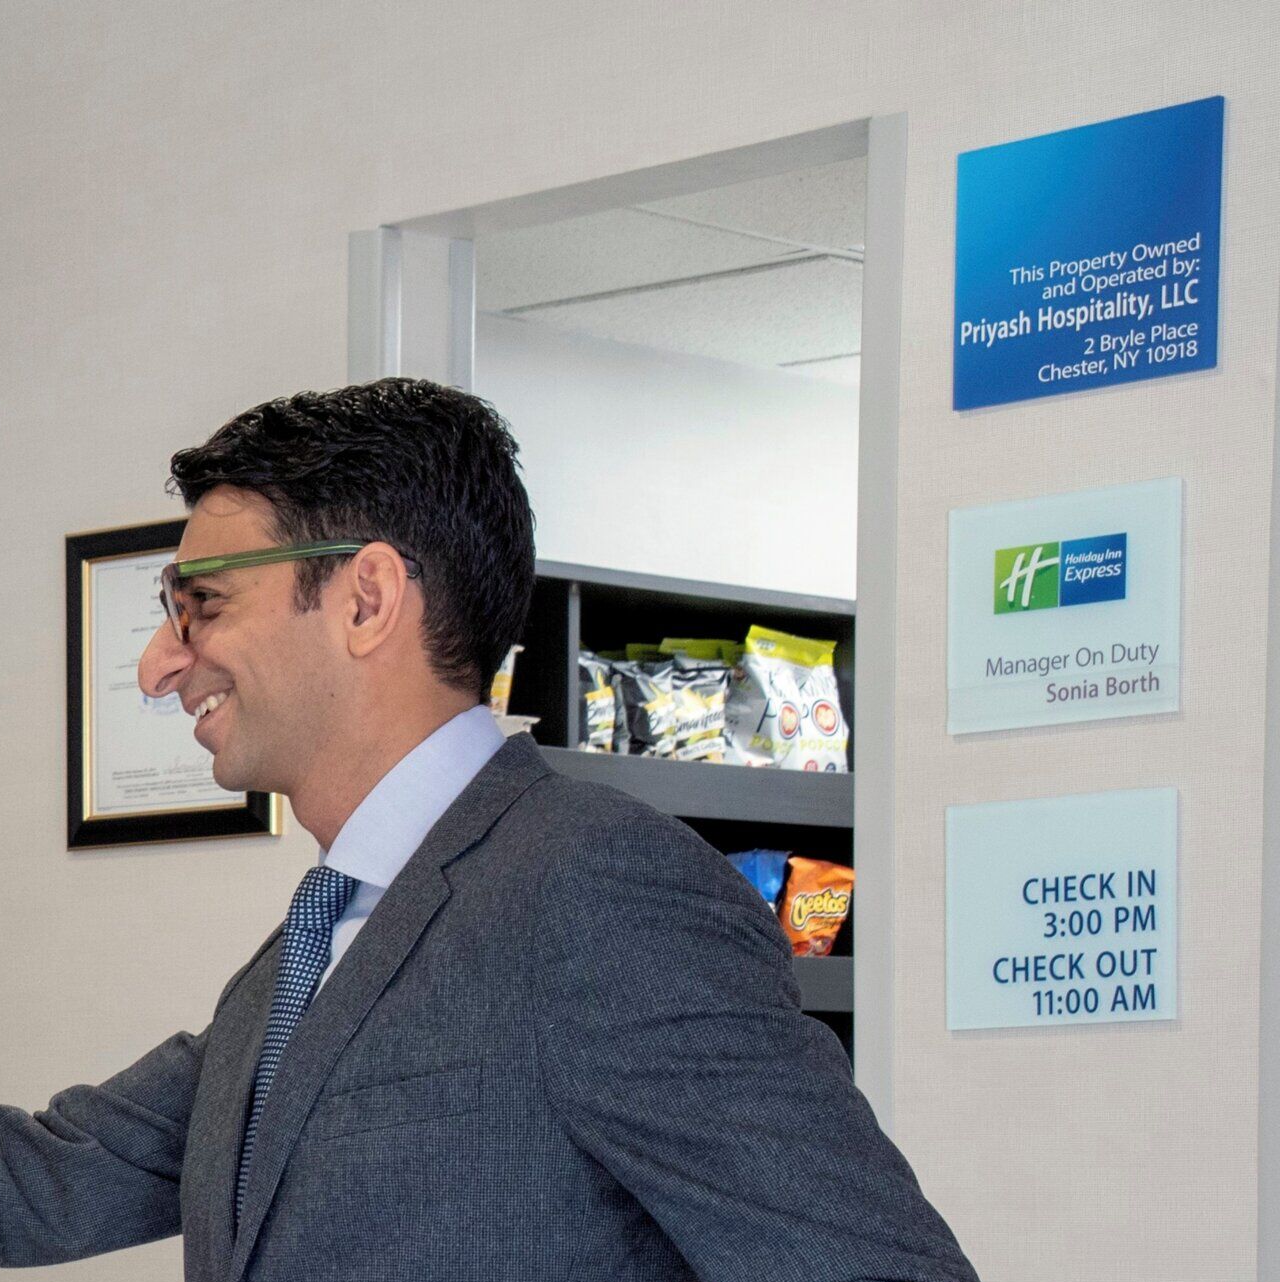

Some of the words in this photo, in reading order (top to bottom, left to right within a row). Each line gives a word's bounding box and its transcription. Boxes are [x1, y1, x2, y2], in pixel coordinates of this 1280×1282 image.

[1010, 266, 1044, 286] This
[1050, 251, 1127, 279] Property
[1132, 232, 1200, 261] Owned
[1042, 277, 1076, 299] and
[1081, 261, 1166, 293] Operated
[1172, 256, 1200, 278] by:
[960, 312, 1031, 348] Priyash
[1038, 290, 1154, 332] Hospitality,
[1161, 278, 1199, 309] LLC
[1084, 337, 1094, 355] 2
[1100, 328, 1146, 354] Bryle
[1151, 322, 1198, 344] Place
[1038, 359, 1108, 383] Chester,
[1113, 350, 1140, 372] NY
[1146, 340, 1198, 365] 10918
[1064, 551, 1105, 566] Holiday
[1105, 549, 1122, 560] Inn
[1064, 563, 1122, 583] Express
[985, 653, 1070, 677] Manager
[1075, 647, 1104, 668] On
[1111, 642, 1160, 665] Duty
[1046, 679, 1099, 703] Sonia
[1105, 671, 1160, 697] Borth
[1022, 871, 1116, 905] CHECK
[1128, 869, 1156, 898] IN
[1043, 909, 1102, 938] 3:00
[1114, 904, 1156, 933] PM
[992, 952, 1085, 984] CHECK
[1096, 948, 1157, 978] OUT
[1032, 987, 1099, 1016] 11:00
[1110, 983, 1156, 1012] AM
